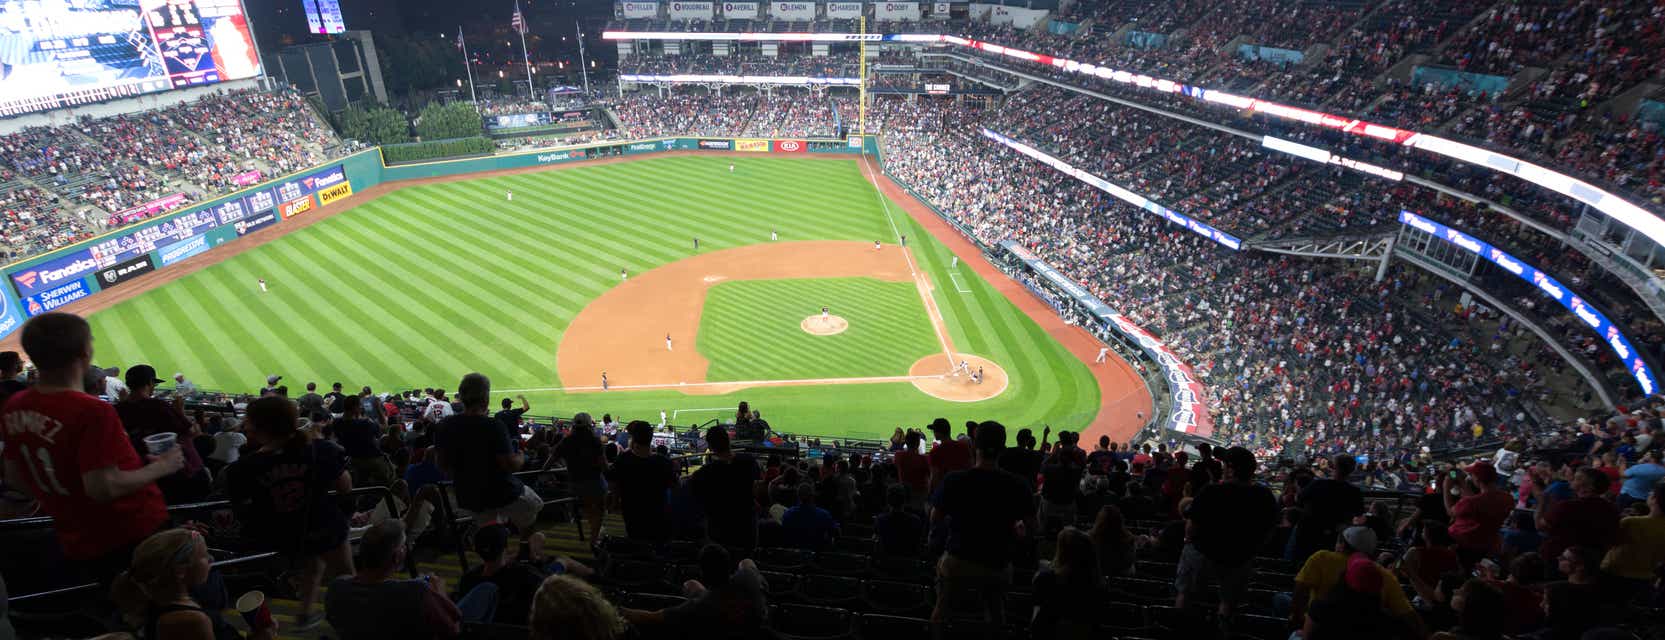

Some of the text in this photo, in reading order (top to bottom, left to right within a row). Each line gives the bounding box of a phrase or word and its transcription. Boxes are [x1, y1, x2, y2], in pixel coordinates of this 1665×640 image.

[538, 153, 569, 162] KeyBank
[315, 171, 344, 188] Fanatics
[39, 258, 97, 284] Fanatics
[118, 261, 148, 276] RAM
[41, 281, 81, 302] SHERWIN
